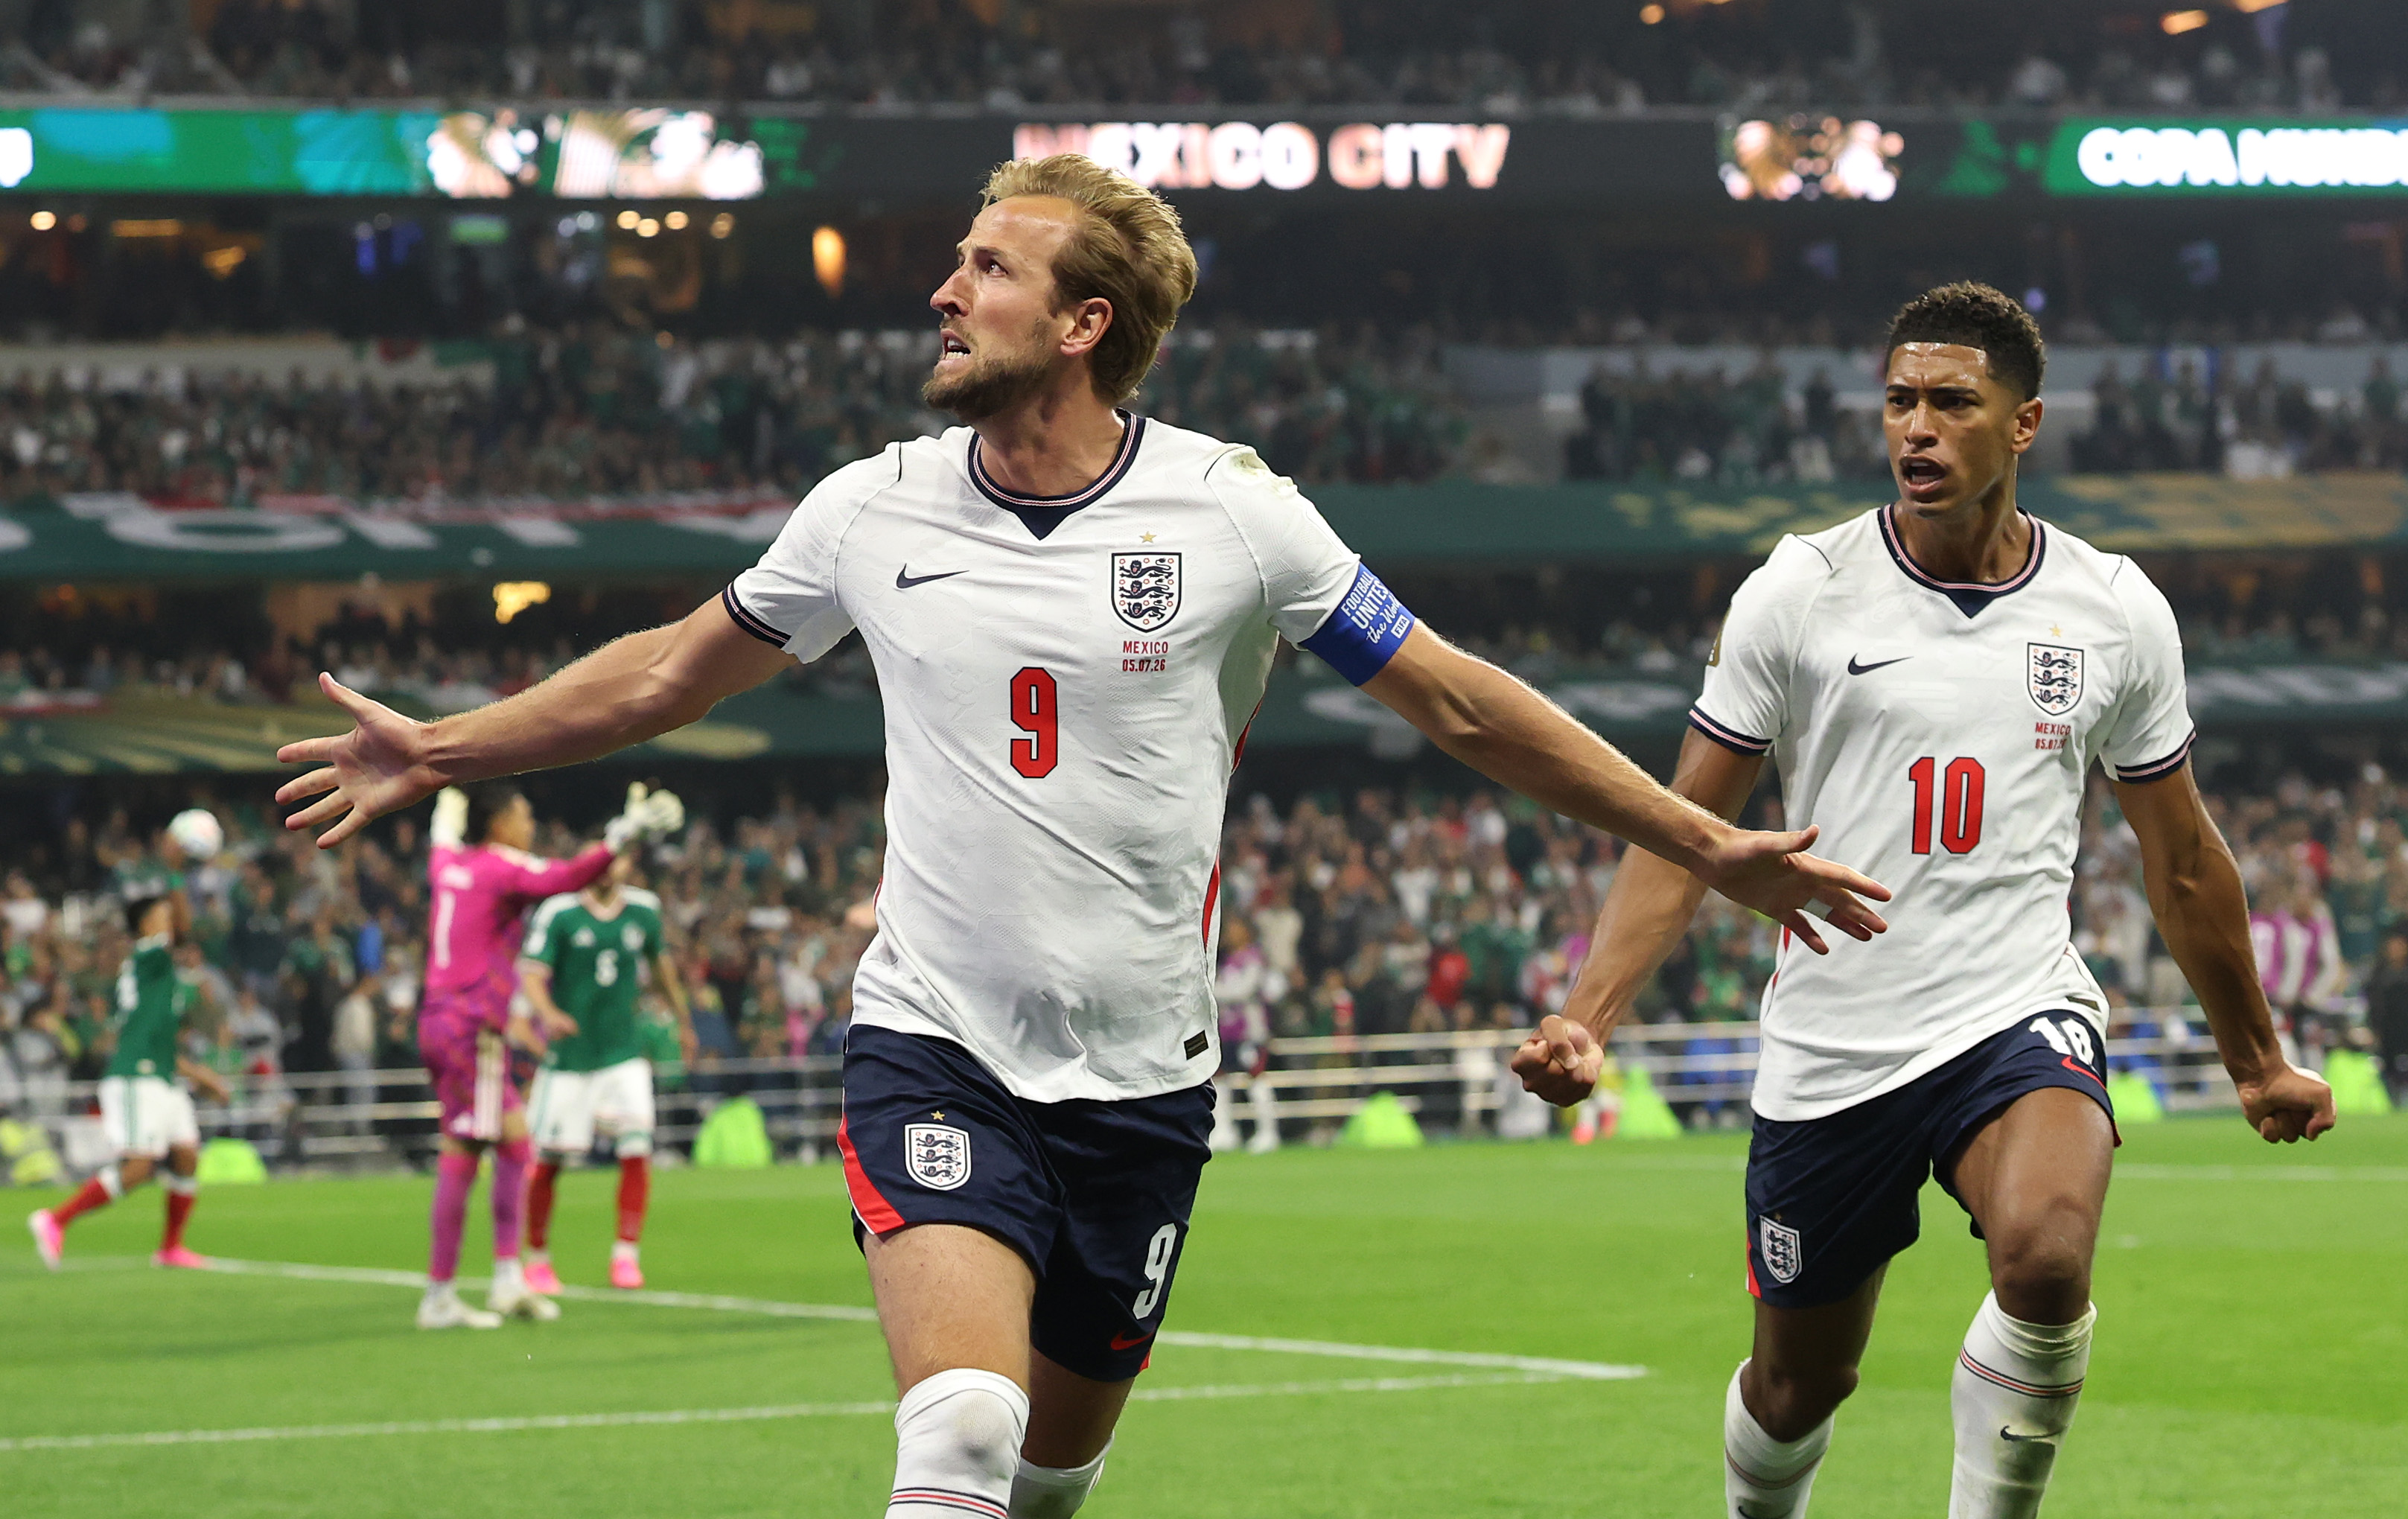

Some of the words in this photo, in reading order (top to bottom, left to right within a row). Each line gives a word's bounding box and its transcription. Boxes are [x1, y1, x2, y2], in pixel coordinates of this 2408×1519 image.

[1328, 122, 1511, 189] CITY
[1341, 571, 1375, 617] FOOTBALL
[1351, 580, 1389, 629] UNITES
[1123, 640, 1168, 654] MEXICO
[1366, 622, 1387, 643] the
[1394, 617, 1408, 635] FIFA
[1122, 659, 1165, 672] 05.07.26
[1010, 666, 1058, 779] 9
[2035, 722, 2071, 736] MEXICO
[1909, 757, 1985, 855] 10
[2028, 1016, 2095, 1066] 10
[1133, 1223, 1177, 1320] 9
